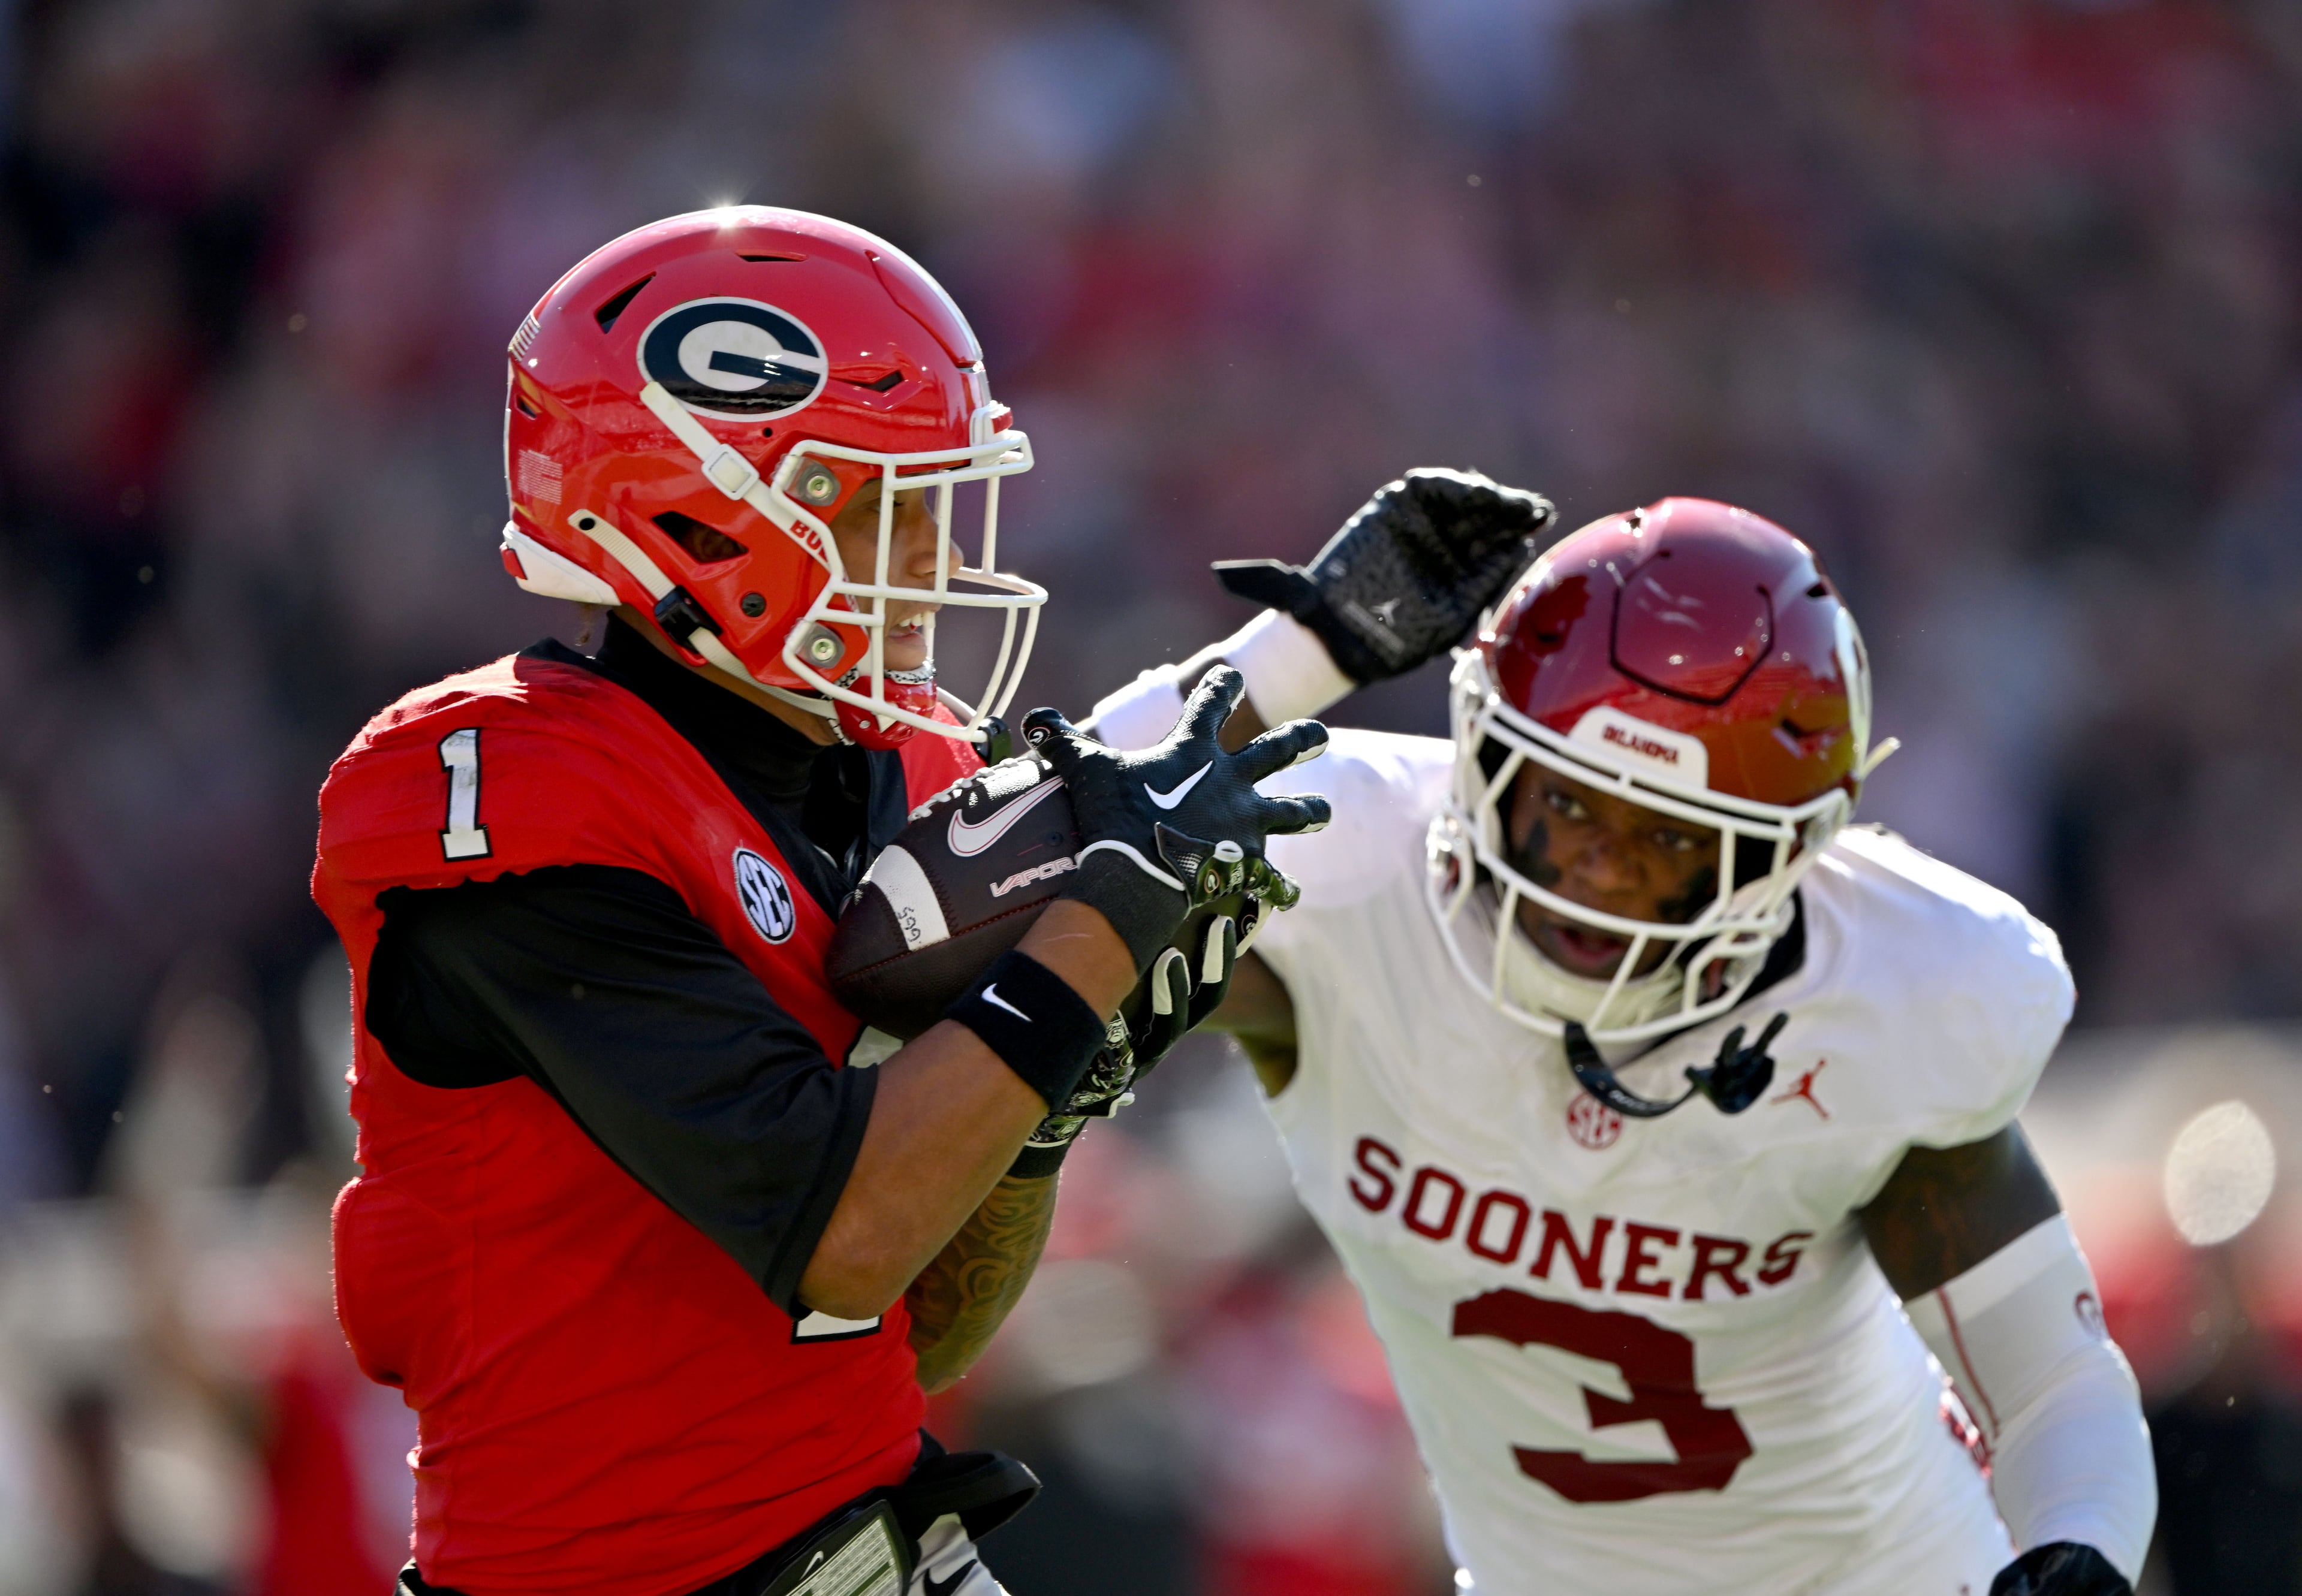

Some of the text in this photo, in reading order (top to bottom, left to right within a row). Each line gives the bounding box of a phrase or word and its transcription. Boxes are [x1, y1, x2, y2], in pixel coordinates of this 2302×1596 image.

[643, 303, 821, 415] G
[436, 726, 493, 863] 1
[737, 852, 793, 938] SEC
[990, 856, 1078, 897] VAPOR
[1348, 1135, 1814, 1301] SOONERS
[1451, 1287, 1756, 1504] 3
